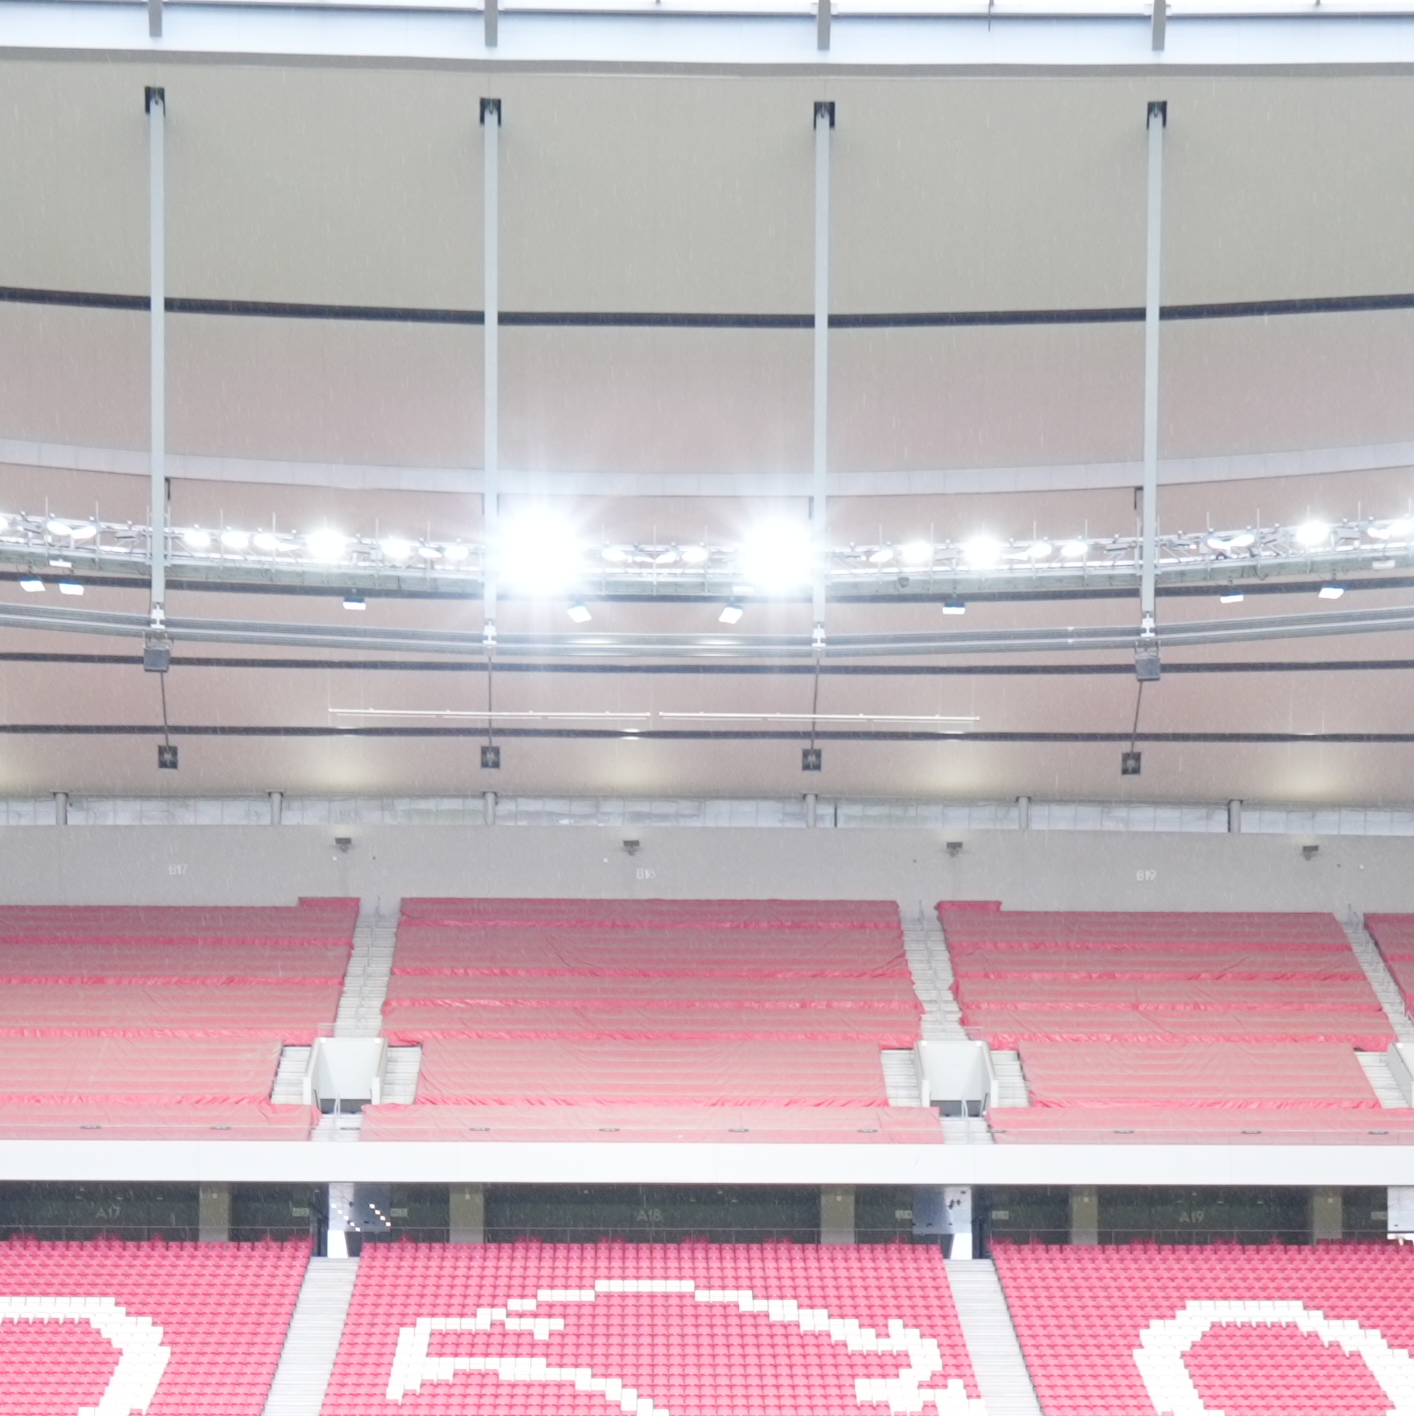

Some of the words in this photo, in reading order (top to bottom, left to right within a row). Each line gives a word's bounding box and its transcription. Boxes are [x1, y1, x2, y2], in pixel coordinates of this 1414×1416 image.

[168, 863, 188, 876] B17
[1136, 869, 1157, 881] B19
[95, 1205, 121, 1219] A17
[636, 1208, 662, 1221] A18
[1179, 1210, 1205, 1223] A19
